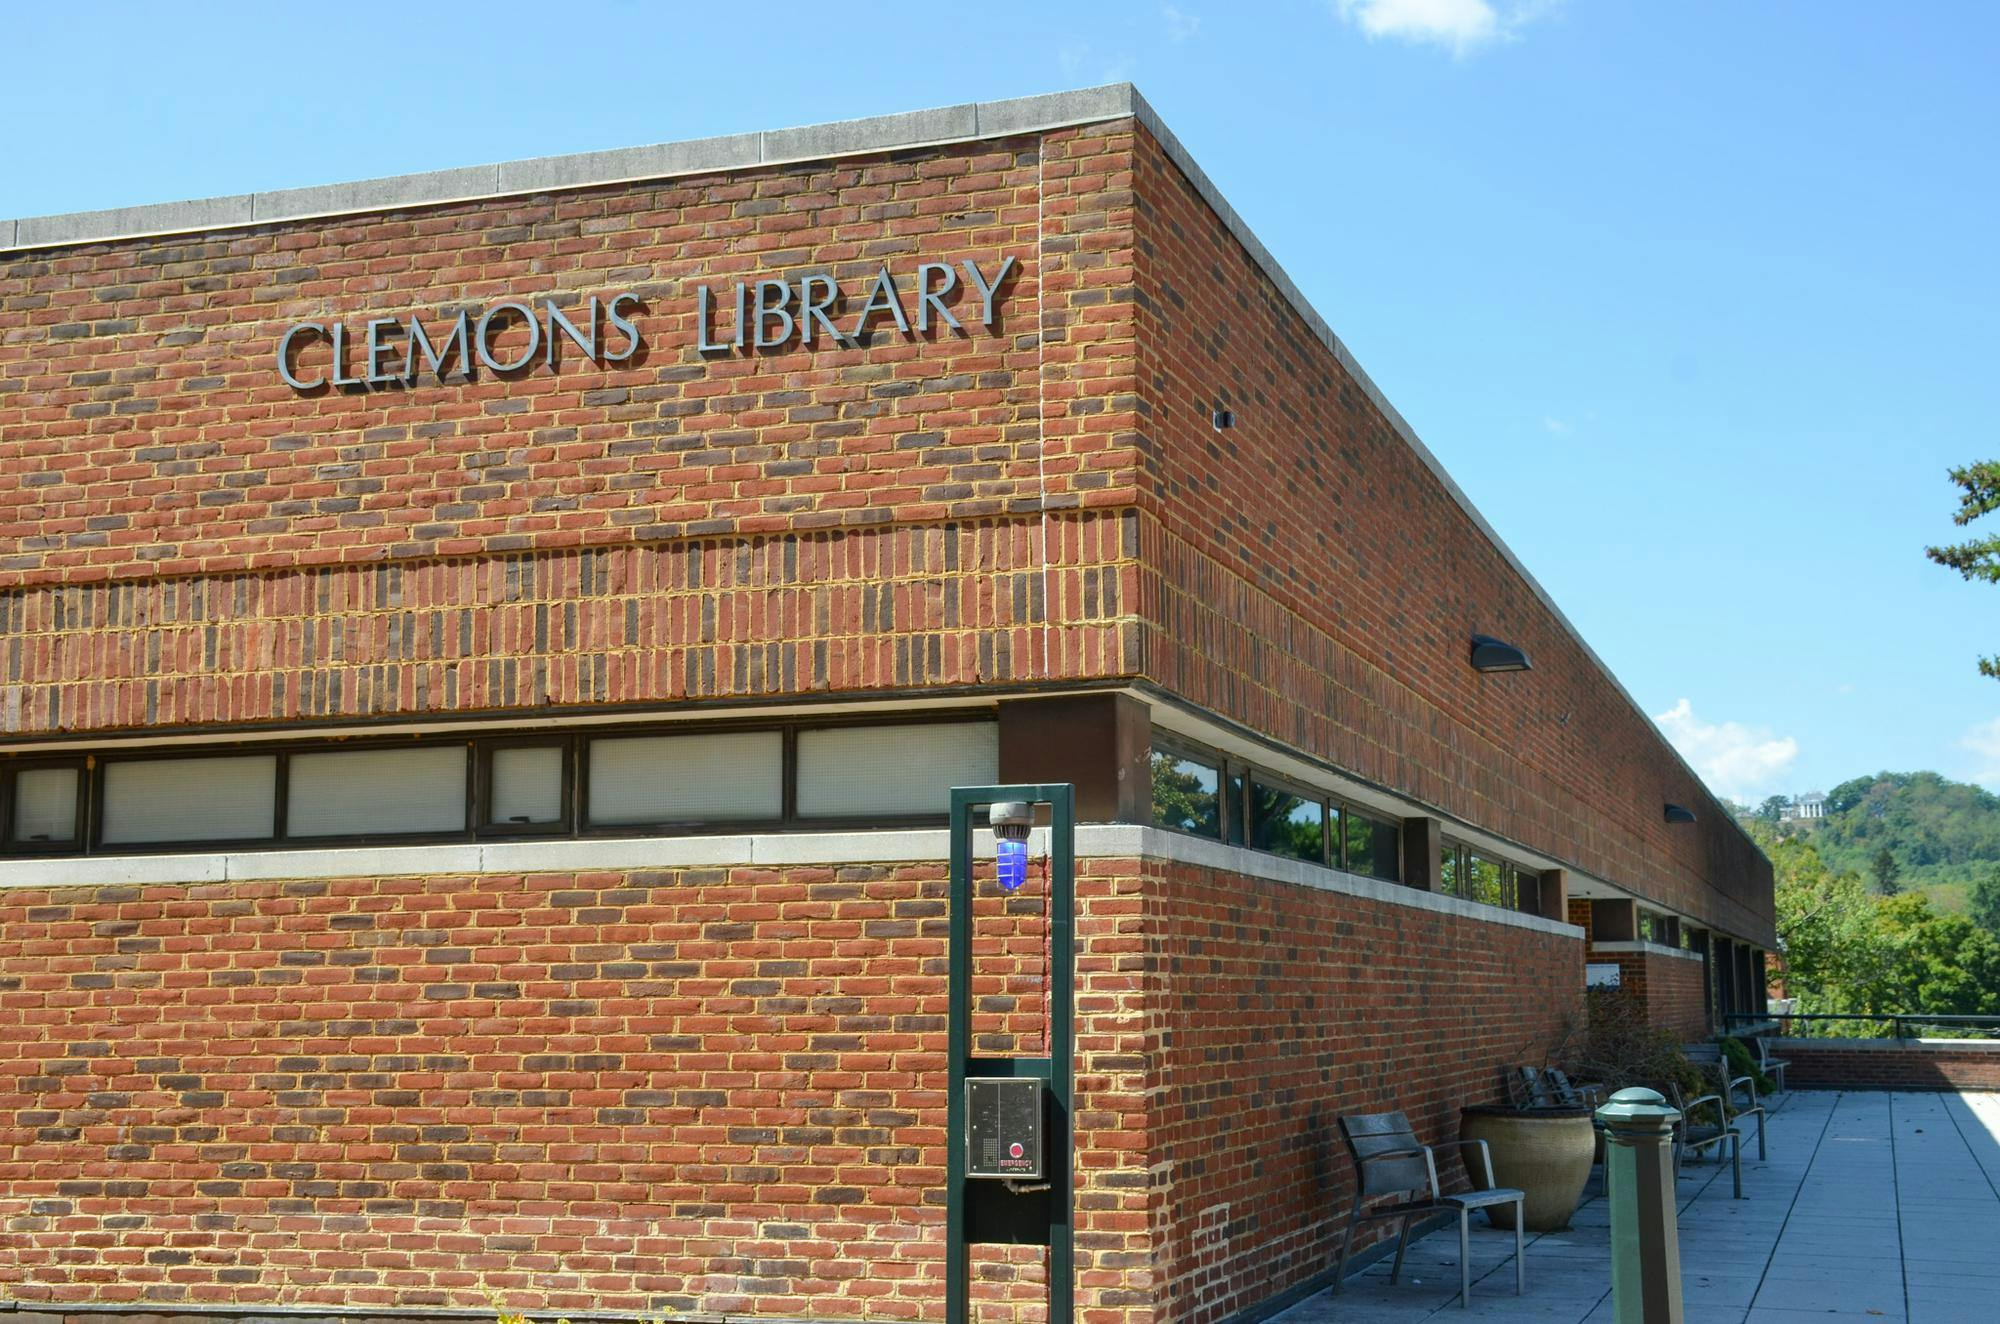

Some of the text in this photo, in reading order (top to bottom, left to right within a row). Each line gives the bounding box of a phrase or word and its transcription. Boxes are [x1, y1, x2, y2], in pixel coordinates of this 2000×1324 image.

[278, 256, 1017, 390] CLEMONS LIBRARY
[1000, 1159, 1032, 1167] EMERGENCY
